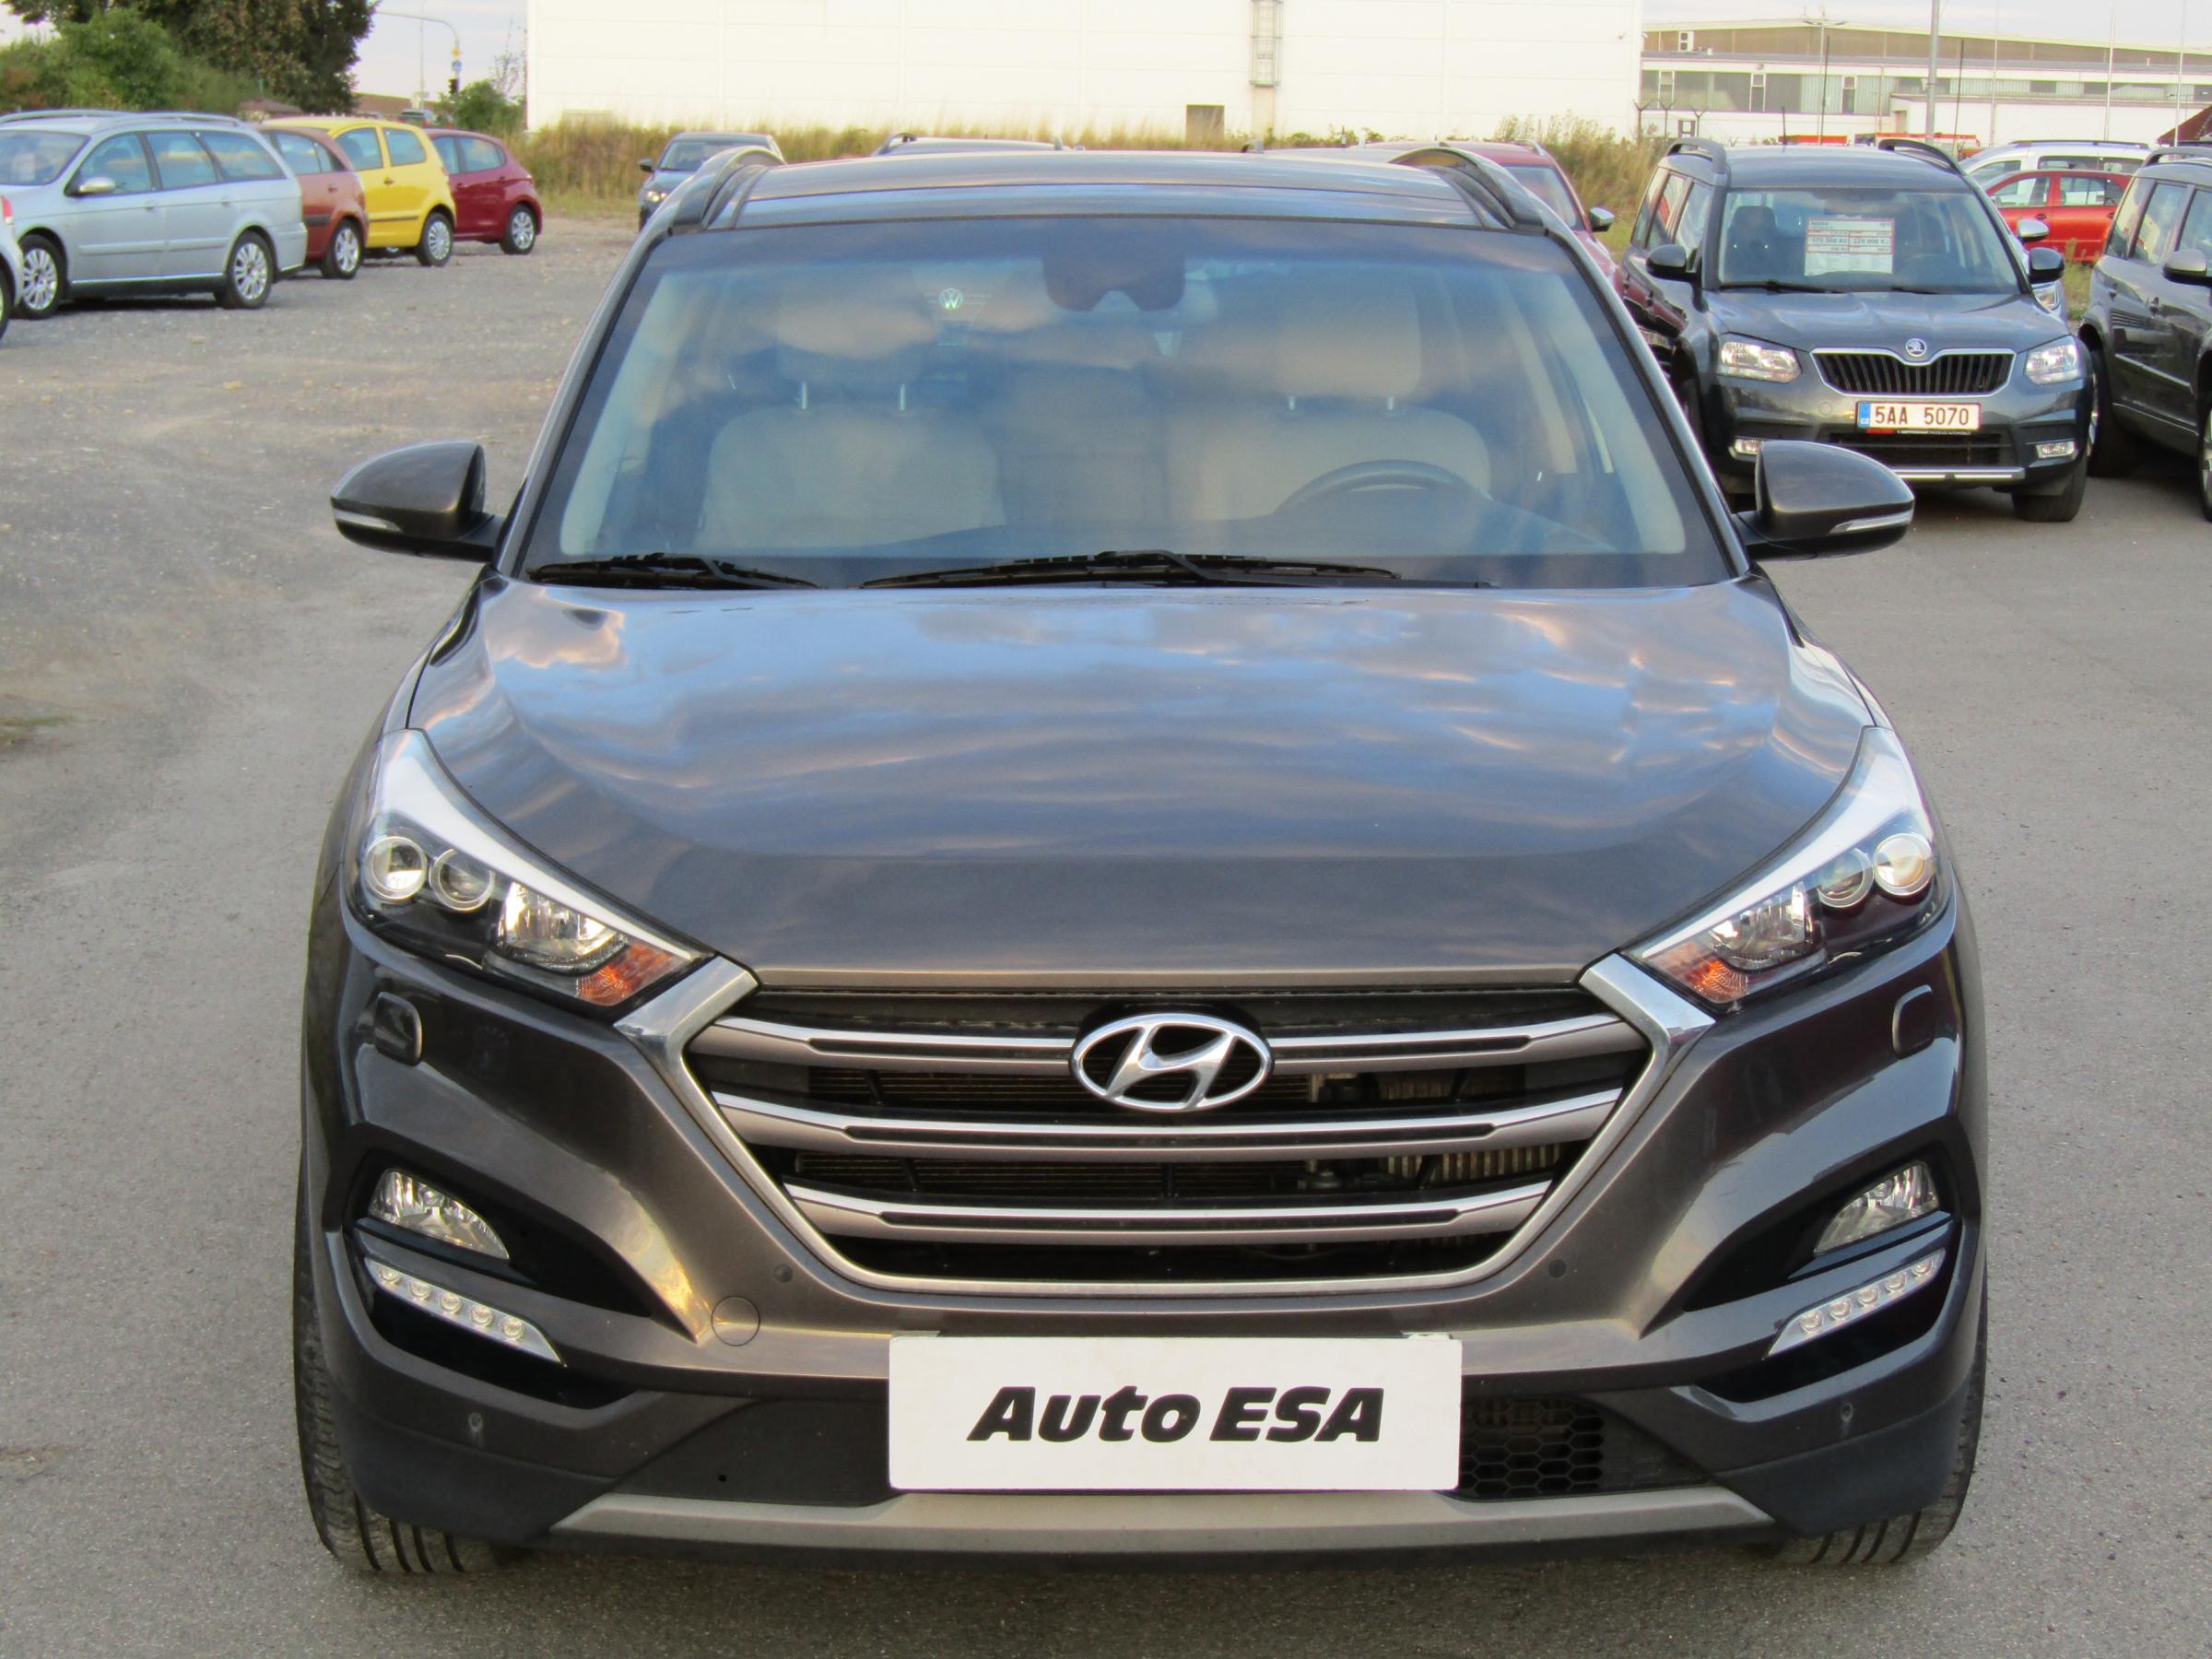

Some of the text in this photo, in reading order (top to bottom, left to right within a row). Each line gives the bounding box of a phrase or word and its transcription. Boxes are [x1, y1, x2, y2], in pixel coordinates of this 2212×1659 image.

[1875, 406, 1970, 426] 5AA 5070
[966, 1385, 1384, 1442] Auto ESA
